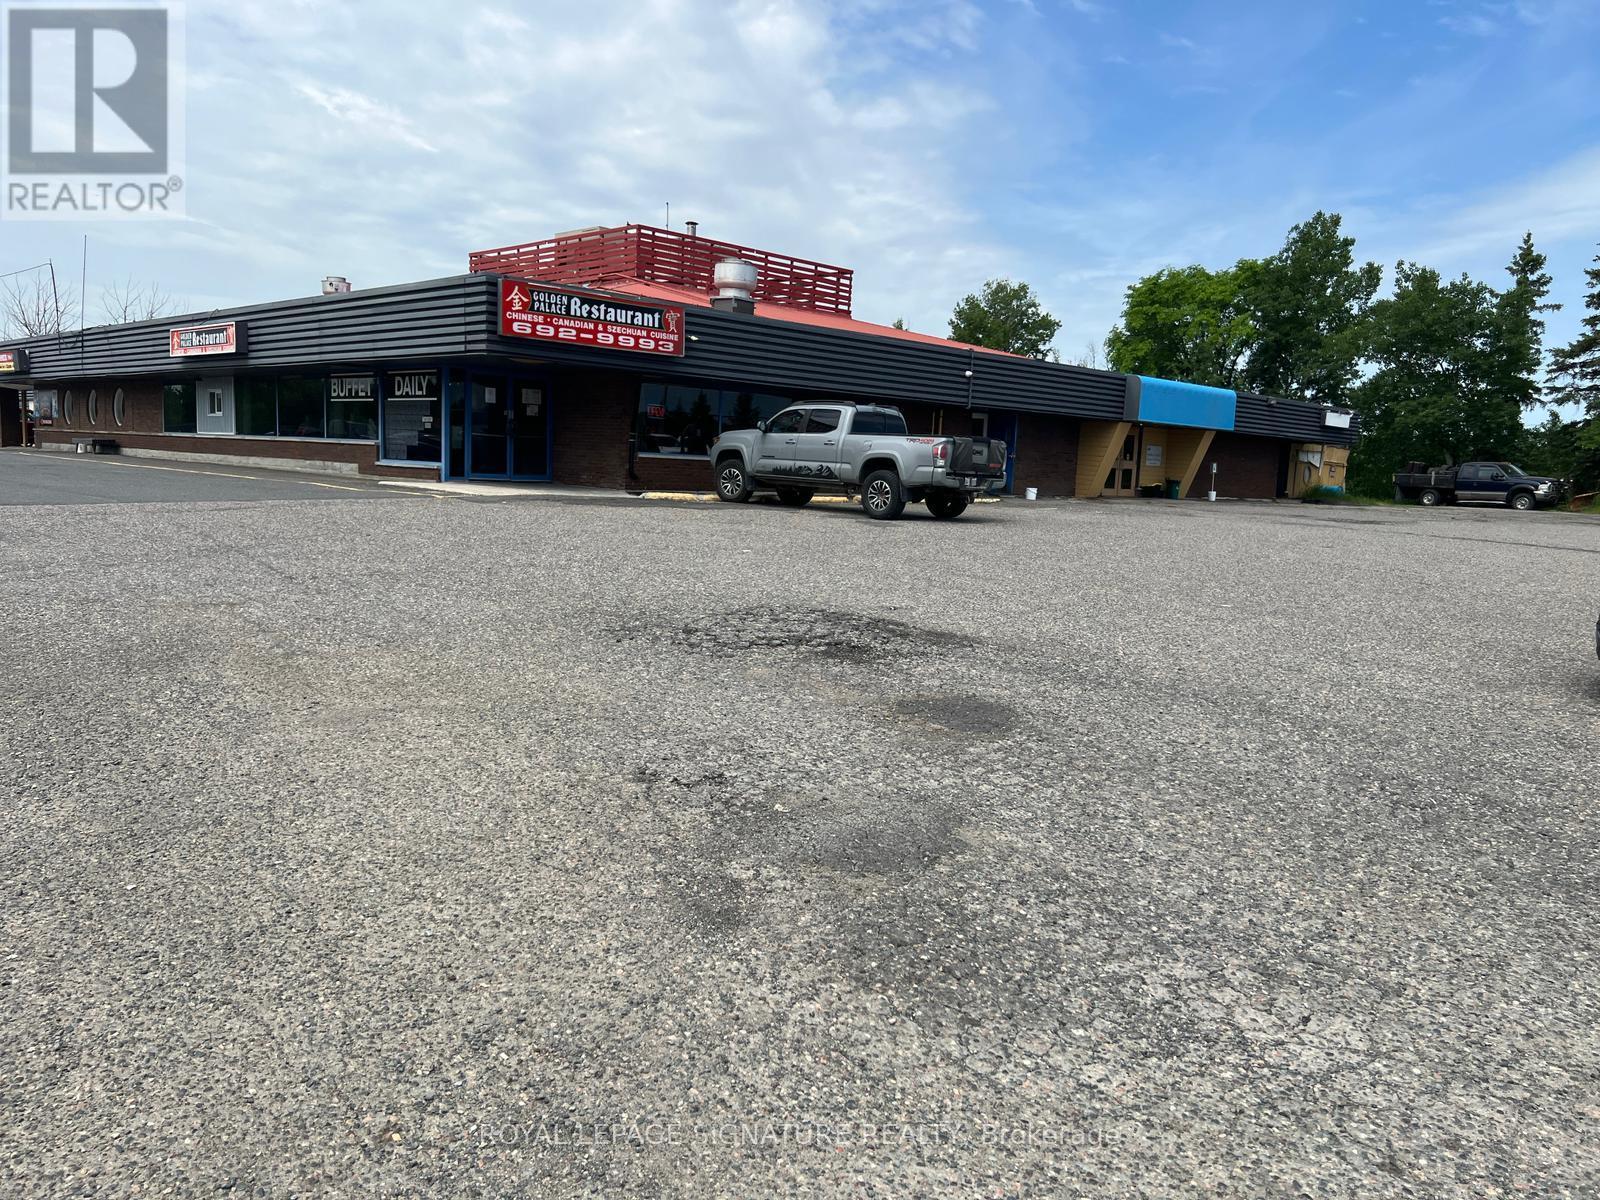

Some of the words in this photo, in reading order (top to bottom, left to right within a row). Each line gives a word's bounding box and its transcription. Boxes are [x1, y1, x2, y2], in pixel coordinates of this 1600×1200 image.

[506, 285, 529, 310] 金
[533, 291, 568, 306] GOLDEN
[534, 301, 567, 315] PALACE
[570, 297, 661, 328] Restaurant
[506, 311, 544, 323] CHINESE
[552, 317, 594, 330] CANADIAN
[598, 323, 603, 331] &
[607, 325, 647, 338] SZECHUAN
[650, 331, 679, 341] CUISINE
[512, 321, 674, 352] 692-9993
[192, 330, 227, 346] Restaurant
[331, 378, 373, 397] BUFFET
[394, 375, 428, 396] DAILY
